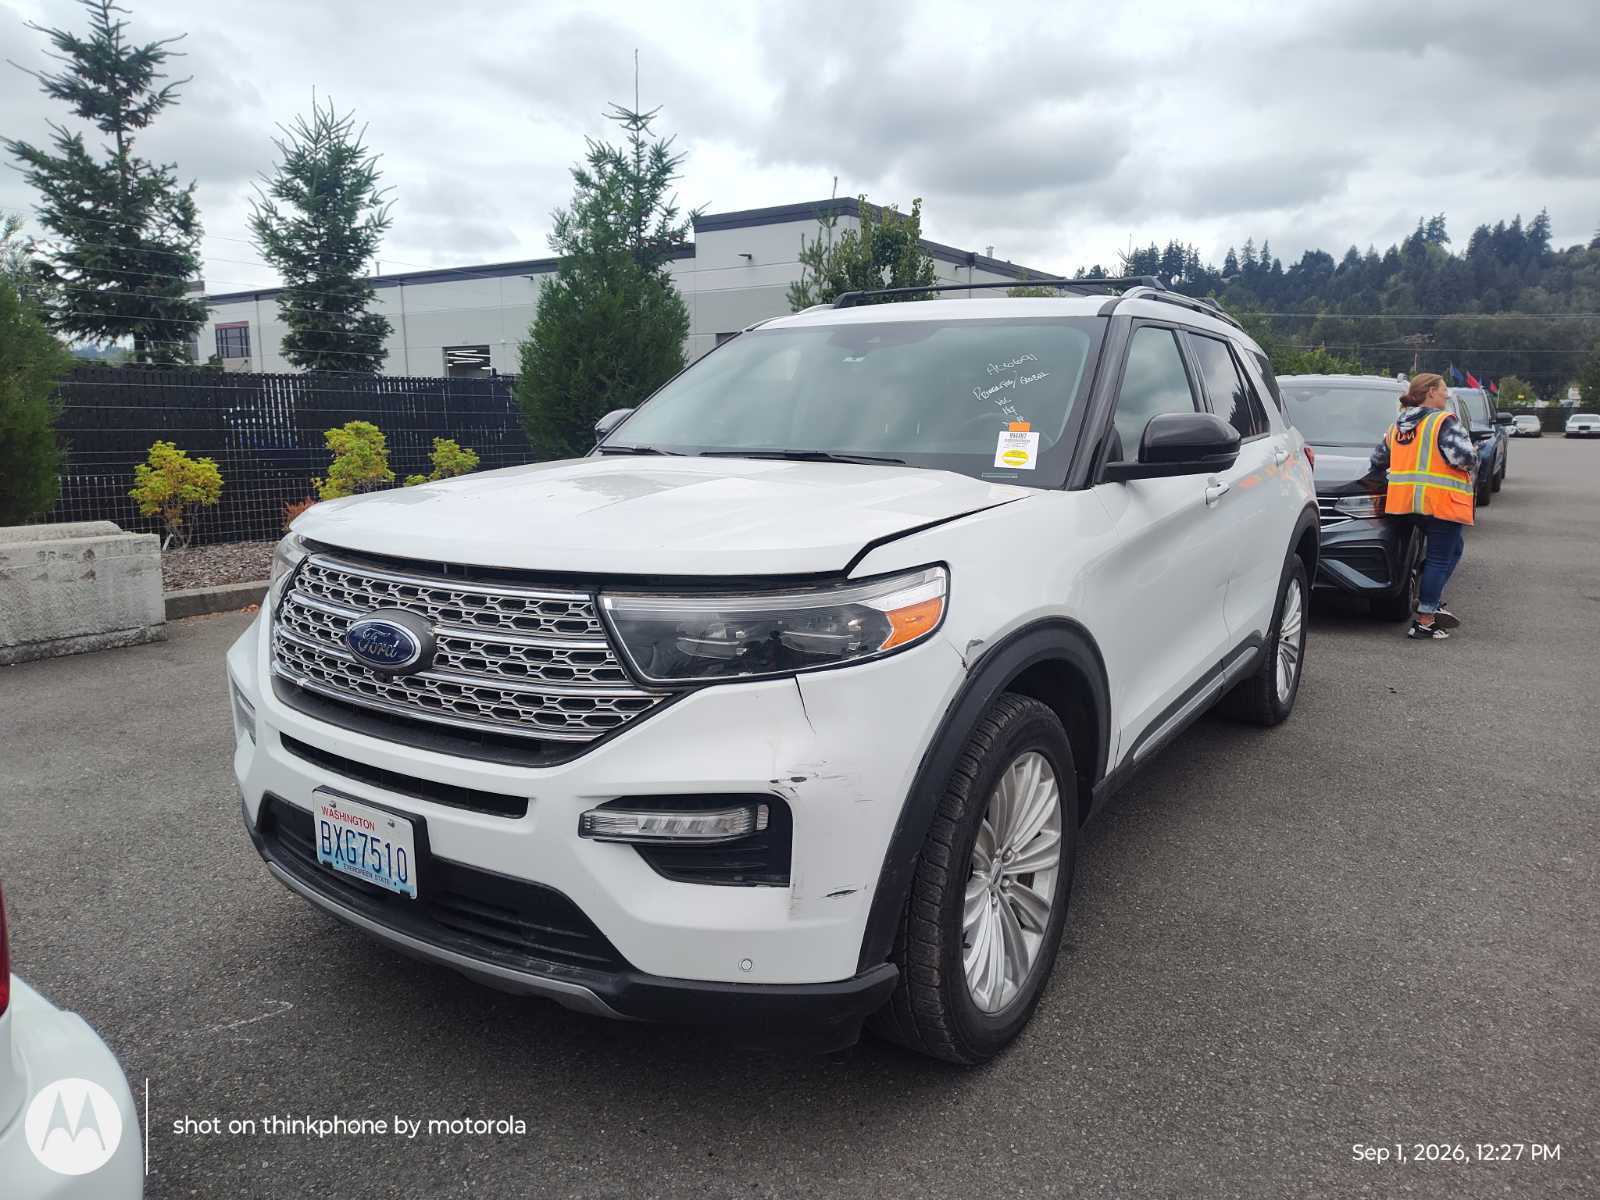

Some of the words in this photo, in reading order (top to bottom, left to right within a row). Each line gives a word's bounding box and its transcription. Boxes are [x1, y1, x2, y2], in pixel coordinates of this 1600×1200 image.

[358, 627, 401, 658] Ford
[320, 805, 376, 831] WASHINGTON
[320, 820, 408, 884] BXG7510
